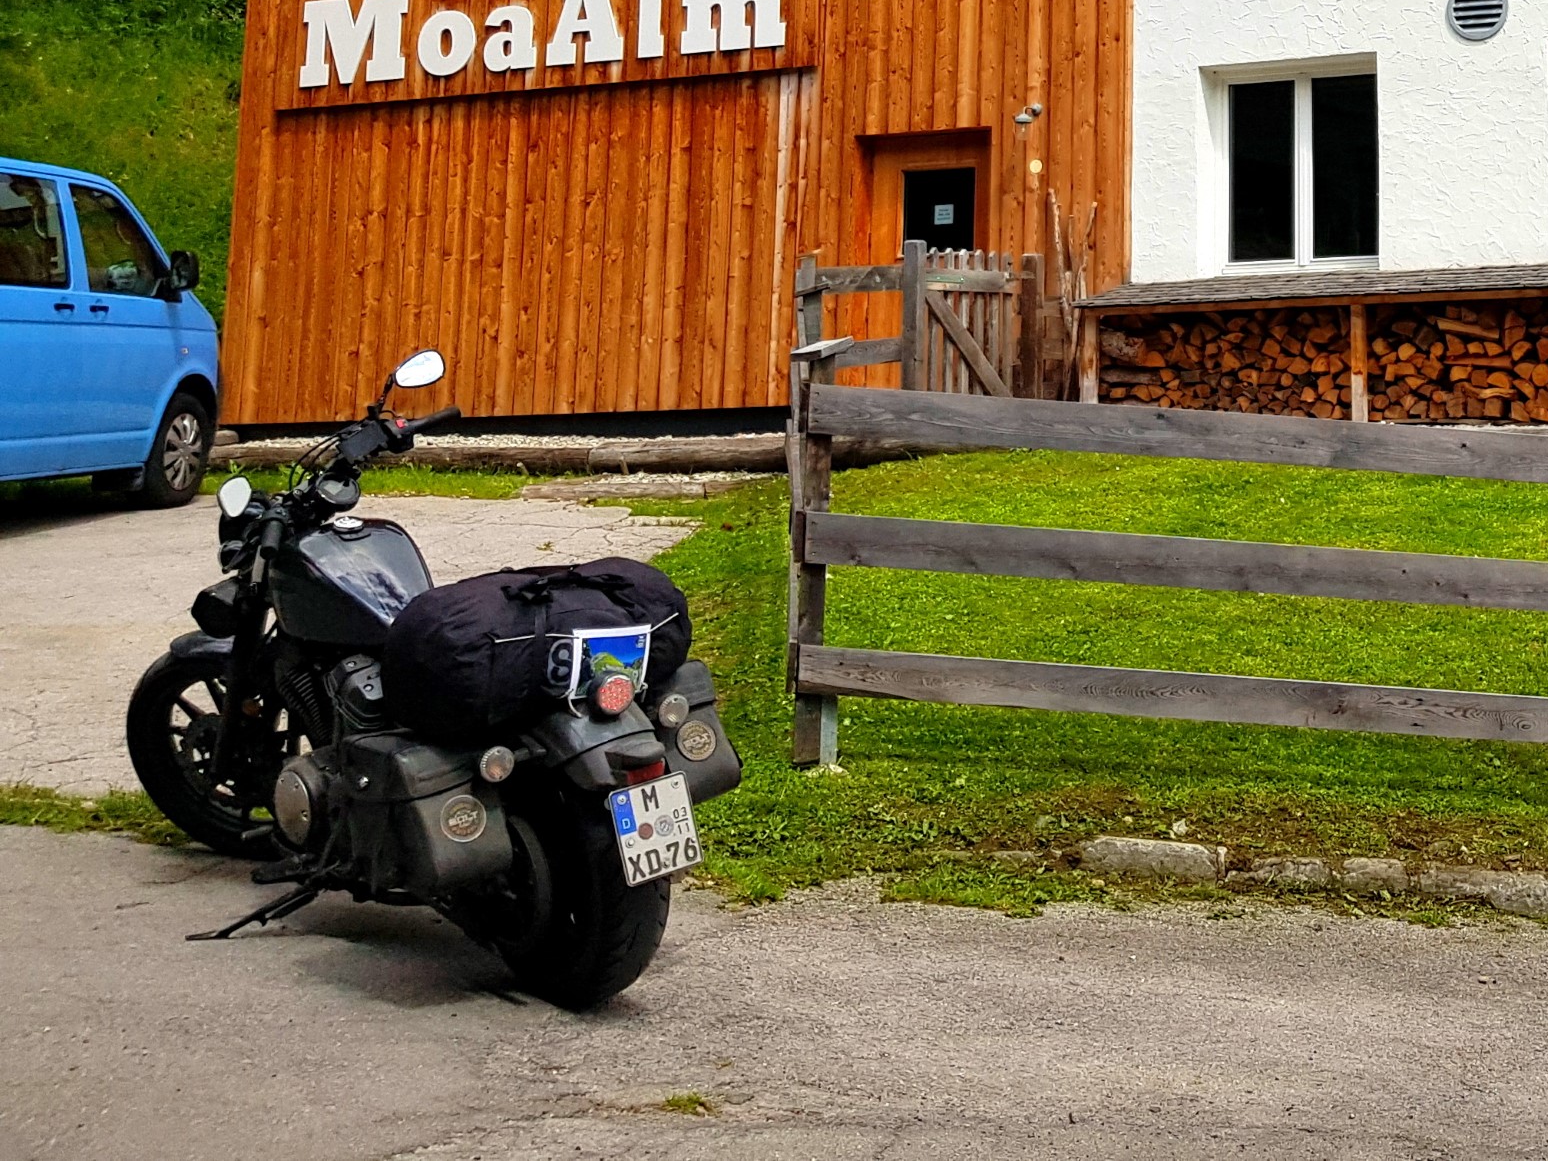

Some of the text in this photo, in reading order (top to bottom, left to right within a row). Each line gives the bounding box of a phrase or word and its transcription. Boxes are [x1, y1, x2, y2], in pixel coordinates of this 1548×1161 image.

[640, 784, 660, 813] M
[672, 806, 688, 820] 03
[622, 818, 631, 830] D
[677, 822, 690, 835] 11
